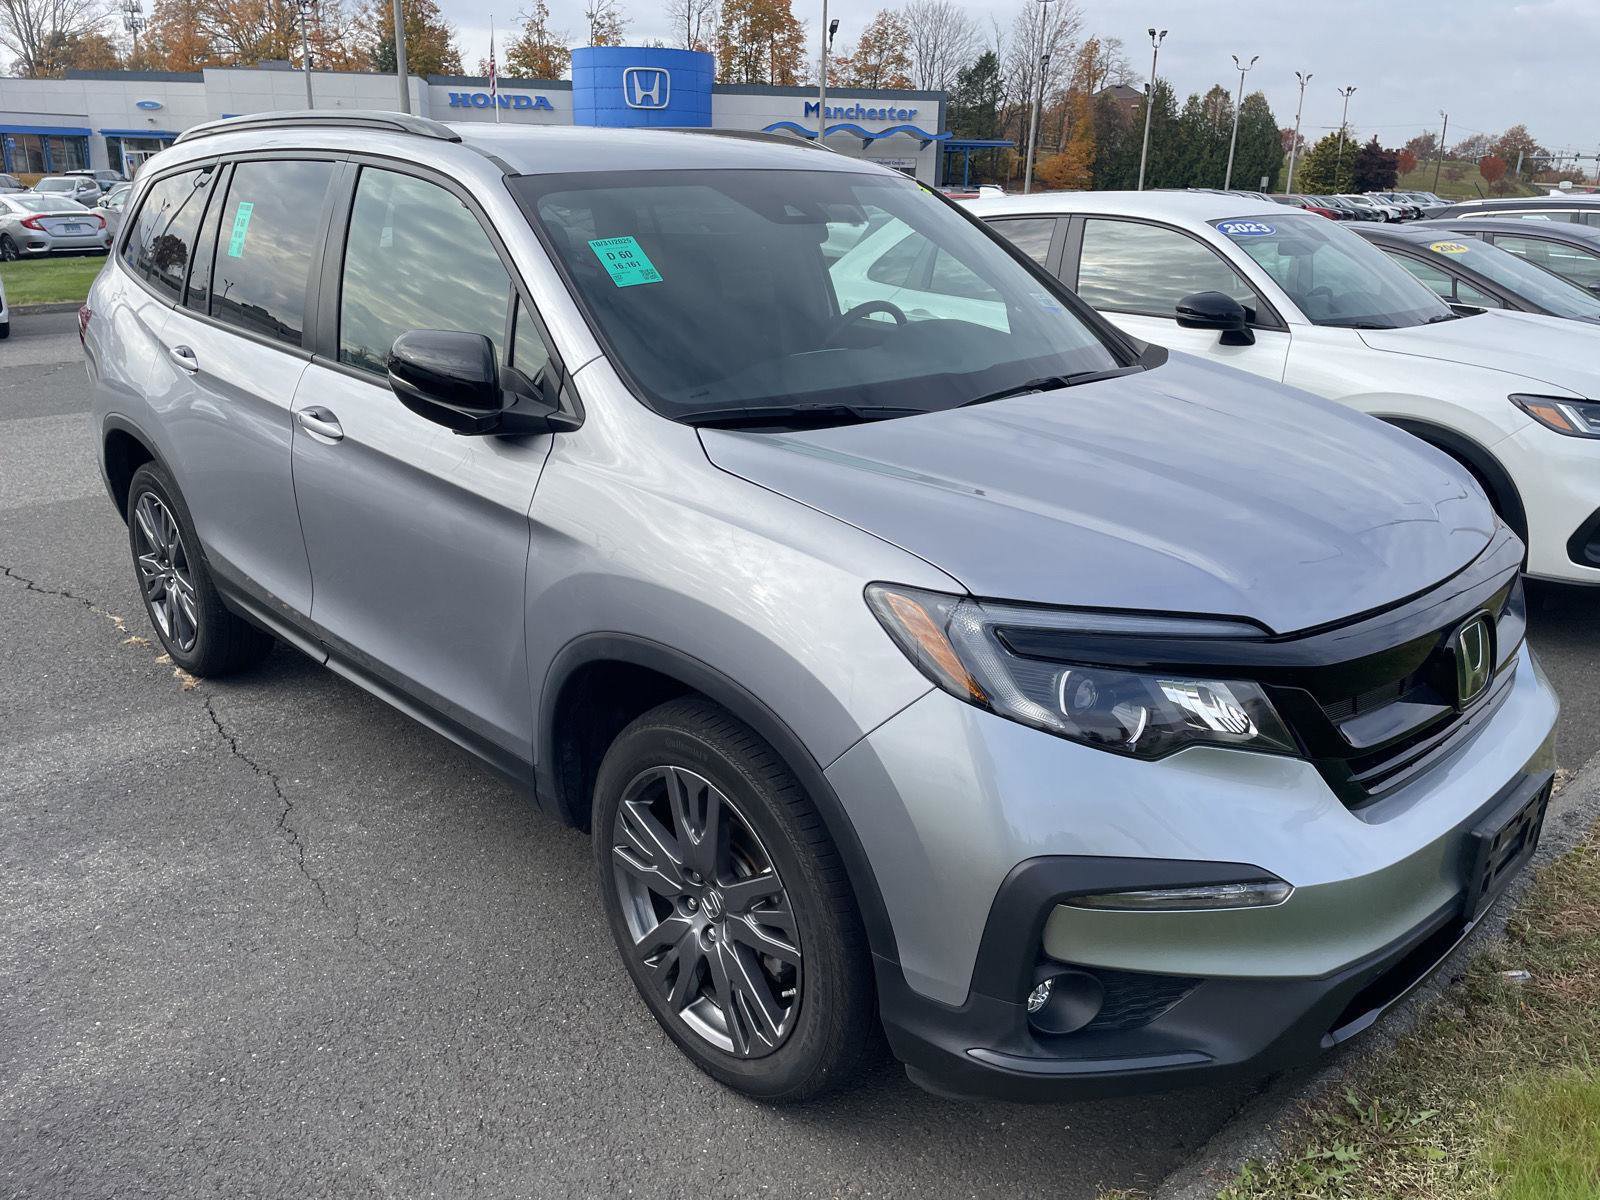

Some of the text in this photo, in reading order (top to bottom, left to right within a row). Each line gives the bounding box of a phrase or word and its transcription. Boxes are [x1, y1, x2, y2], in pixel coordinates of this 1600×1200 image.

[448, 92, 554, 111] HONDA
[804, 101, 918, 121] Manchester
[1223, 223, 1271, 233] 2023
[606, 251, 633, 261] D 60
